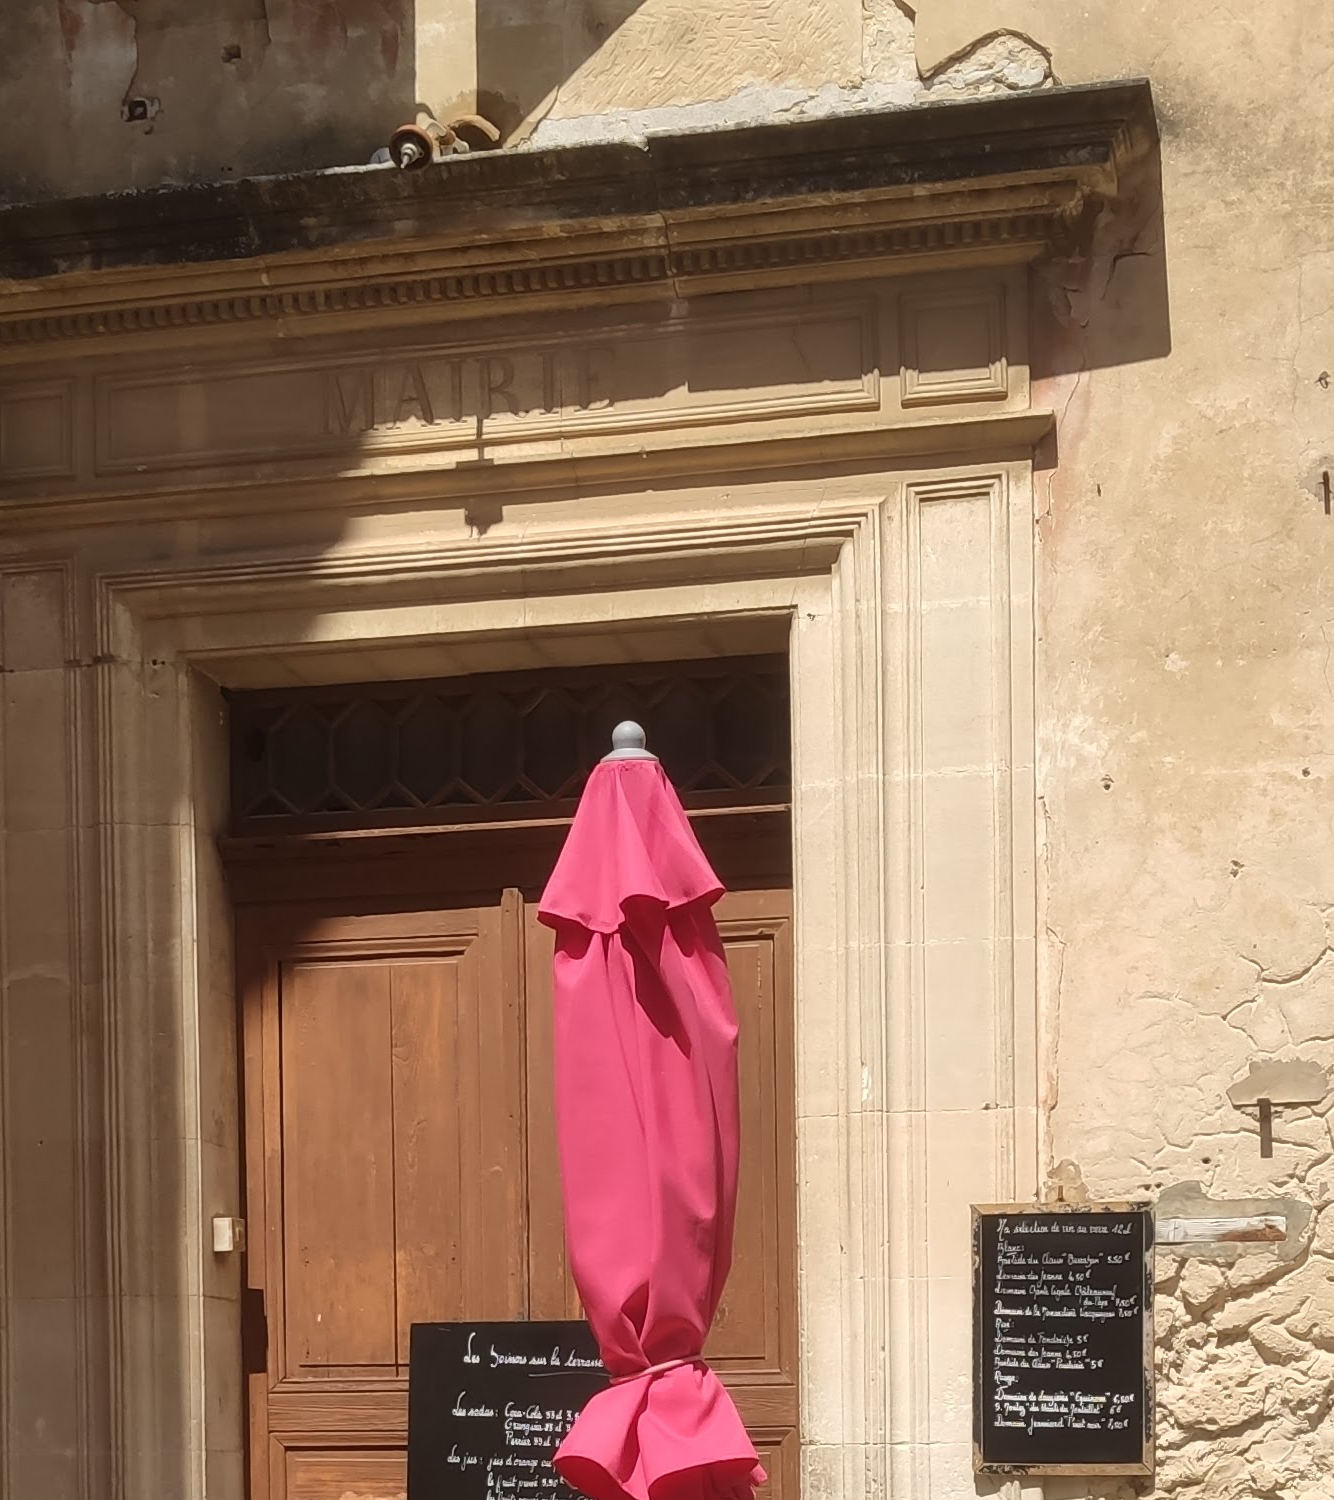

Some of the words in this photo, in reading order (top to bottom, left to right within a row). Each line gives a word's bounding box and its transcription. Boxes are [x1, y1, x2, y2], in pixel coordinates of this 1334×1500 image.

[322, 350, 615, 435] MAIRIE
[1051, 1221, 1060, 1233] de
[528, 1356, 547, 1366] sur
[550, 1346, 560, 1366] la
[565, 1349, 604, 1368] terrasse
